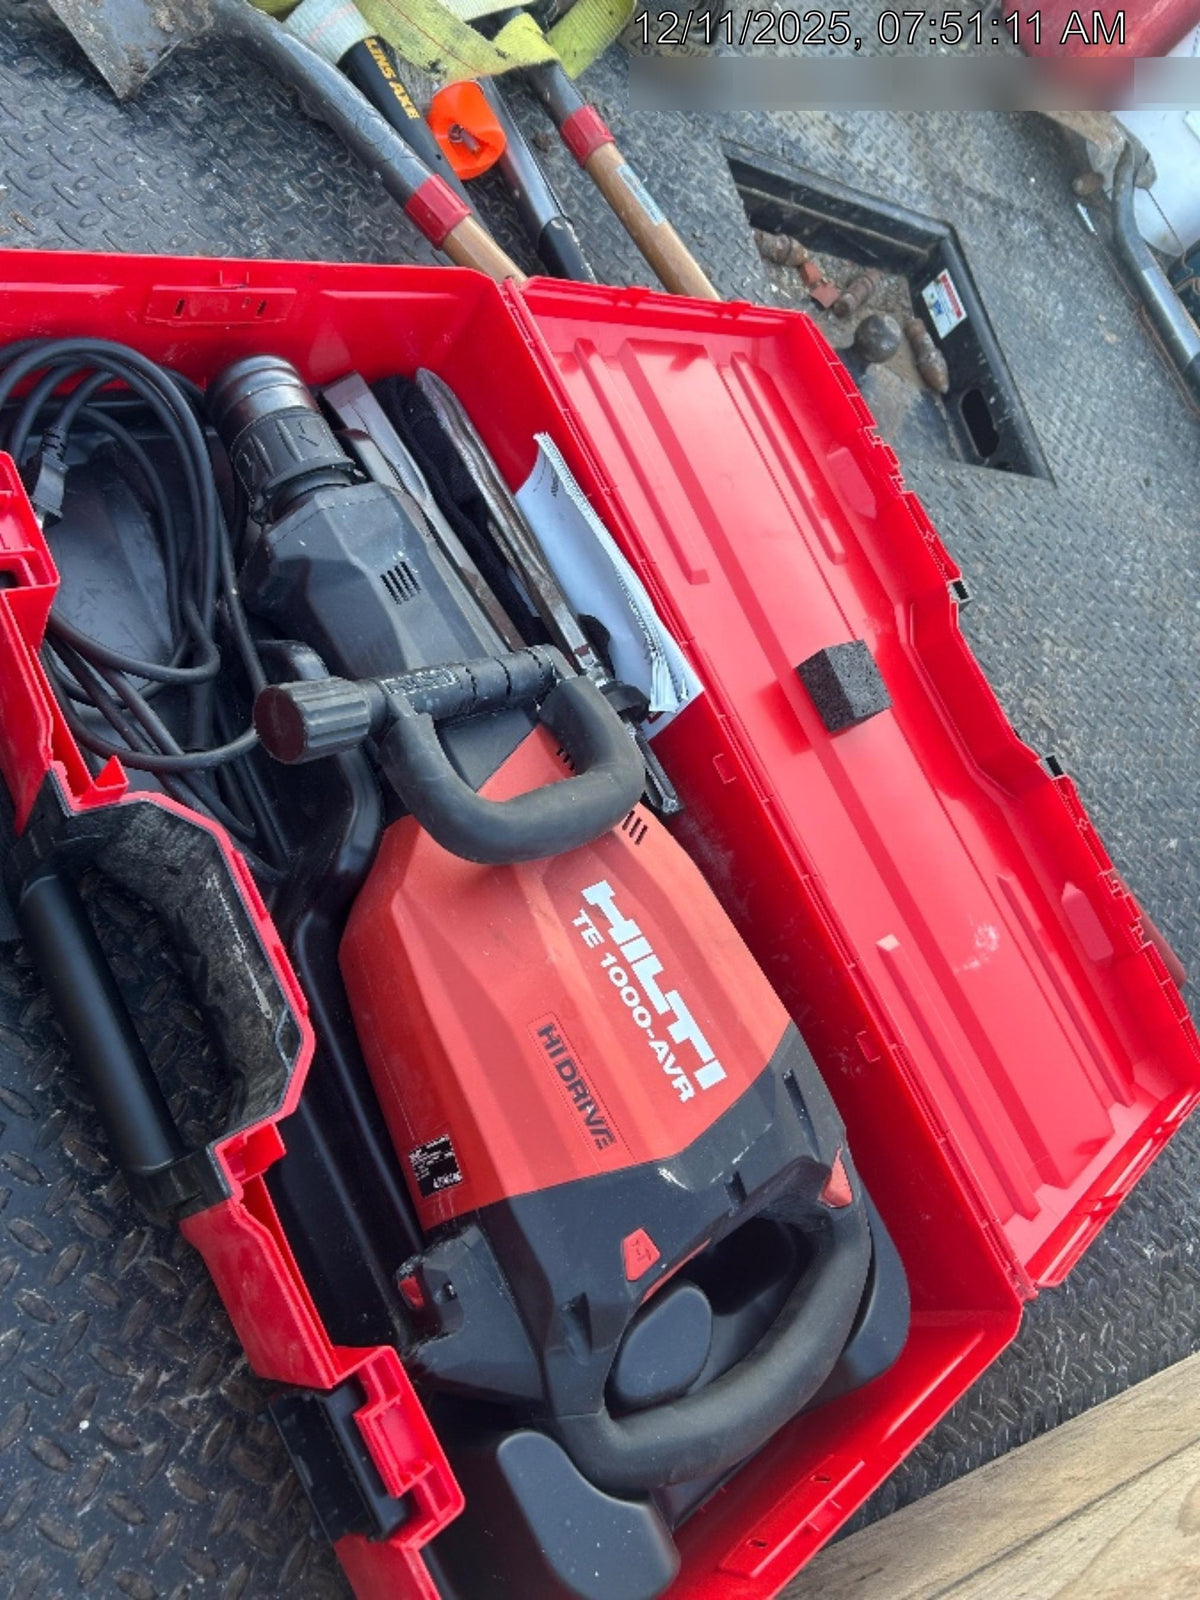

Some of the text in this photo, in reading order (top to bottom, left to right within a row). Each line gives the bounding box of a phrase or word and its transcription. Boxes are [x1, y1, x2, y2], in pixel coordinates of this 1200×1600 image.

[388, 81, 420, 118] AXE
[572, 908, 695, 1103] TE 1000-AVR
[581, 880, 727, 1090] HILTI
